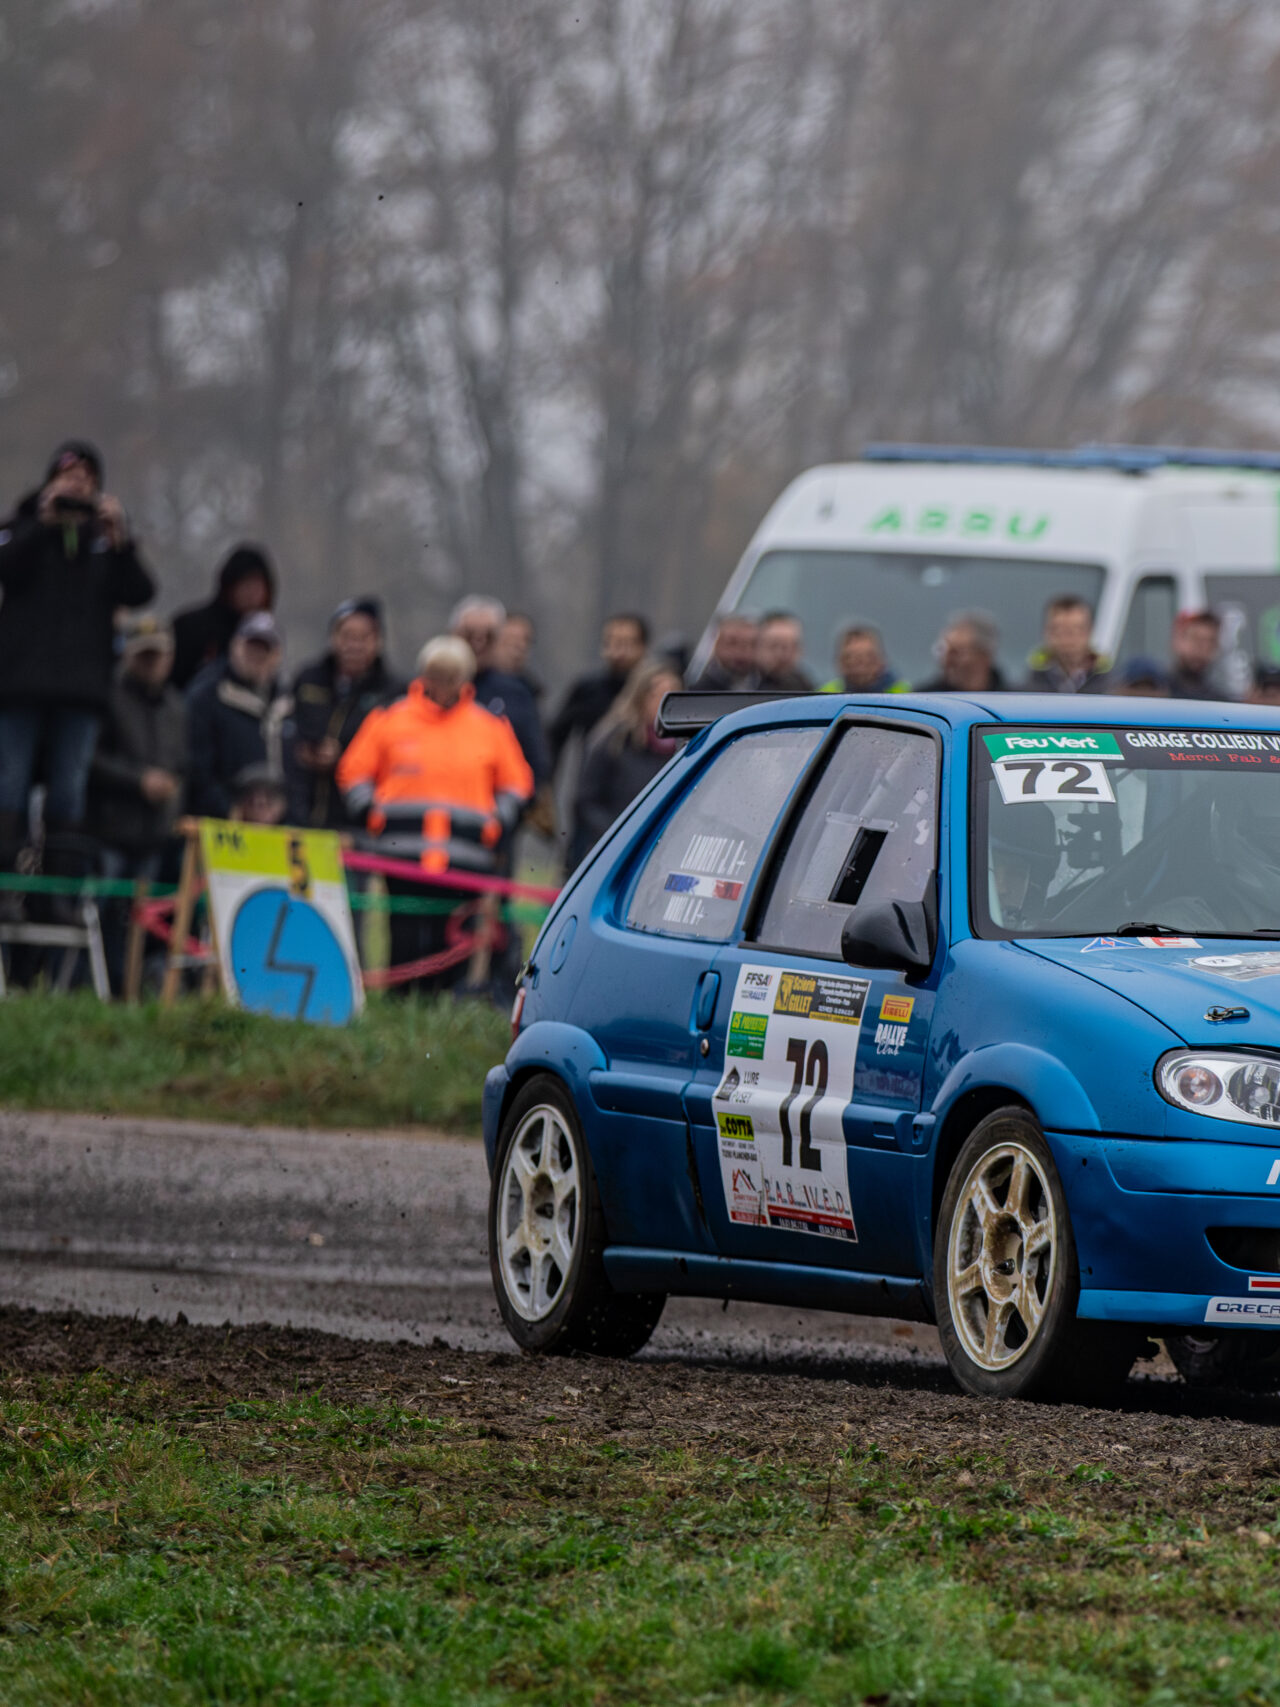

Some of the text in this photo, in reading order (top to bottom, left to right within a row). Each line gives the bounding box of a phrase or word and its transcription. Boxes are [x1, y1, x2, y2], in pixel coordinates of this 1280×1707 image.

[863, 506, 1049, 543] ASSU
[1005, 736, 1099, 749] Feu Vert
[1125, 732, 1193, 748] GARAGE
[1192, 733, 1269, 750] COLLIEUX
[1168, 752, 1221, 762] Merci
[1228, 753, 1262, 764] Fab
[1003, 762, 1100, 795] 72
[288, 838, 310, 893] 5
[744, 972, 769, 986] FFSA
[788, 994, 813, 1013] GILLET
[882, 1000, 910, 1018] PIRELLI
[874, 1022, 908, 1047] RALLYE
[743, 1070, 760, 1086] LURE
[779, 1037, 828, 1172] 72
[725, 1117, 754, 1137] COTTA
